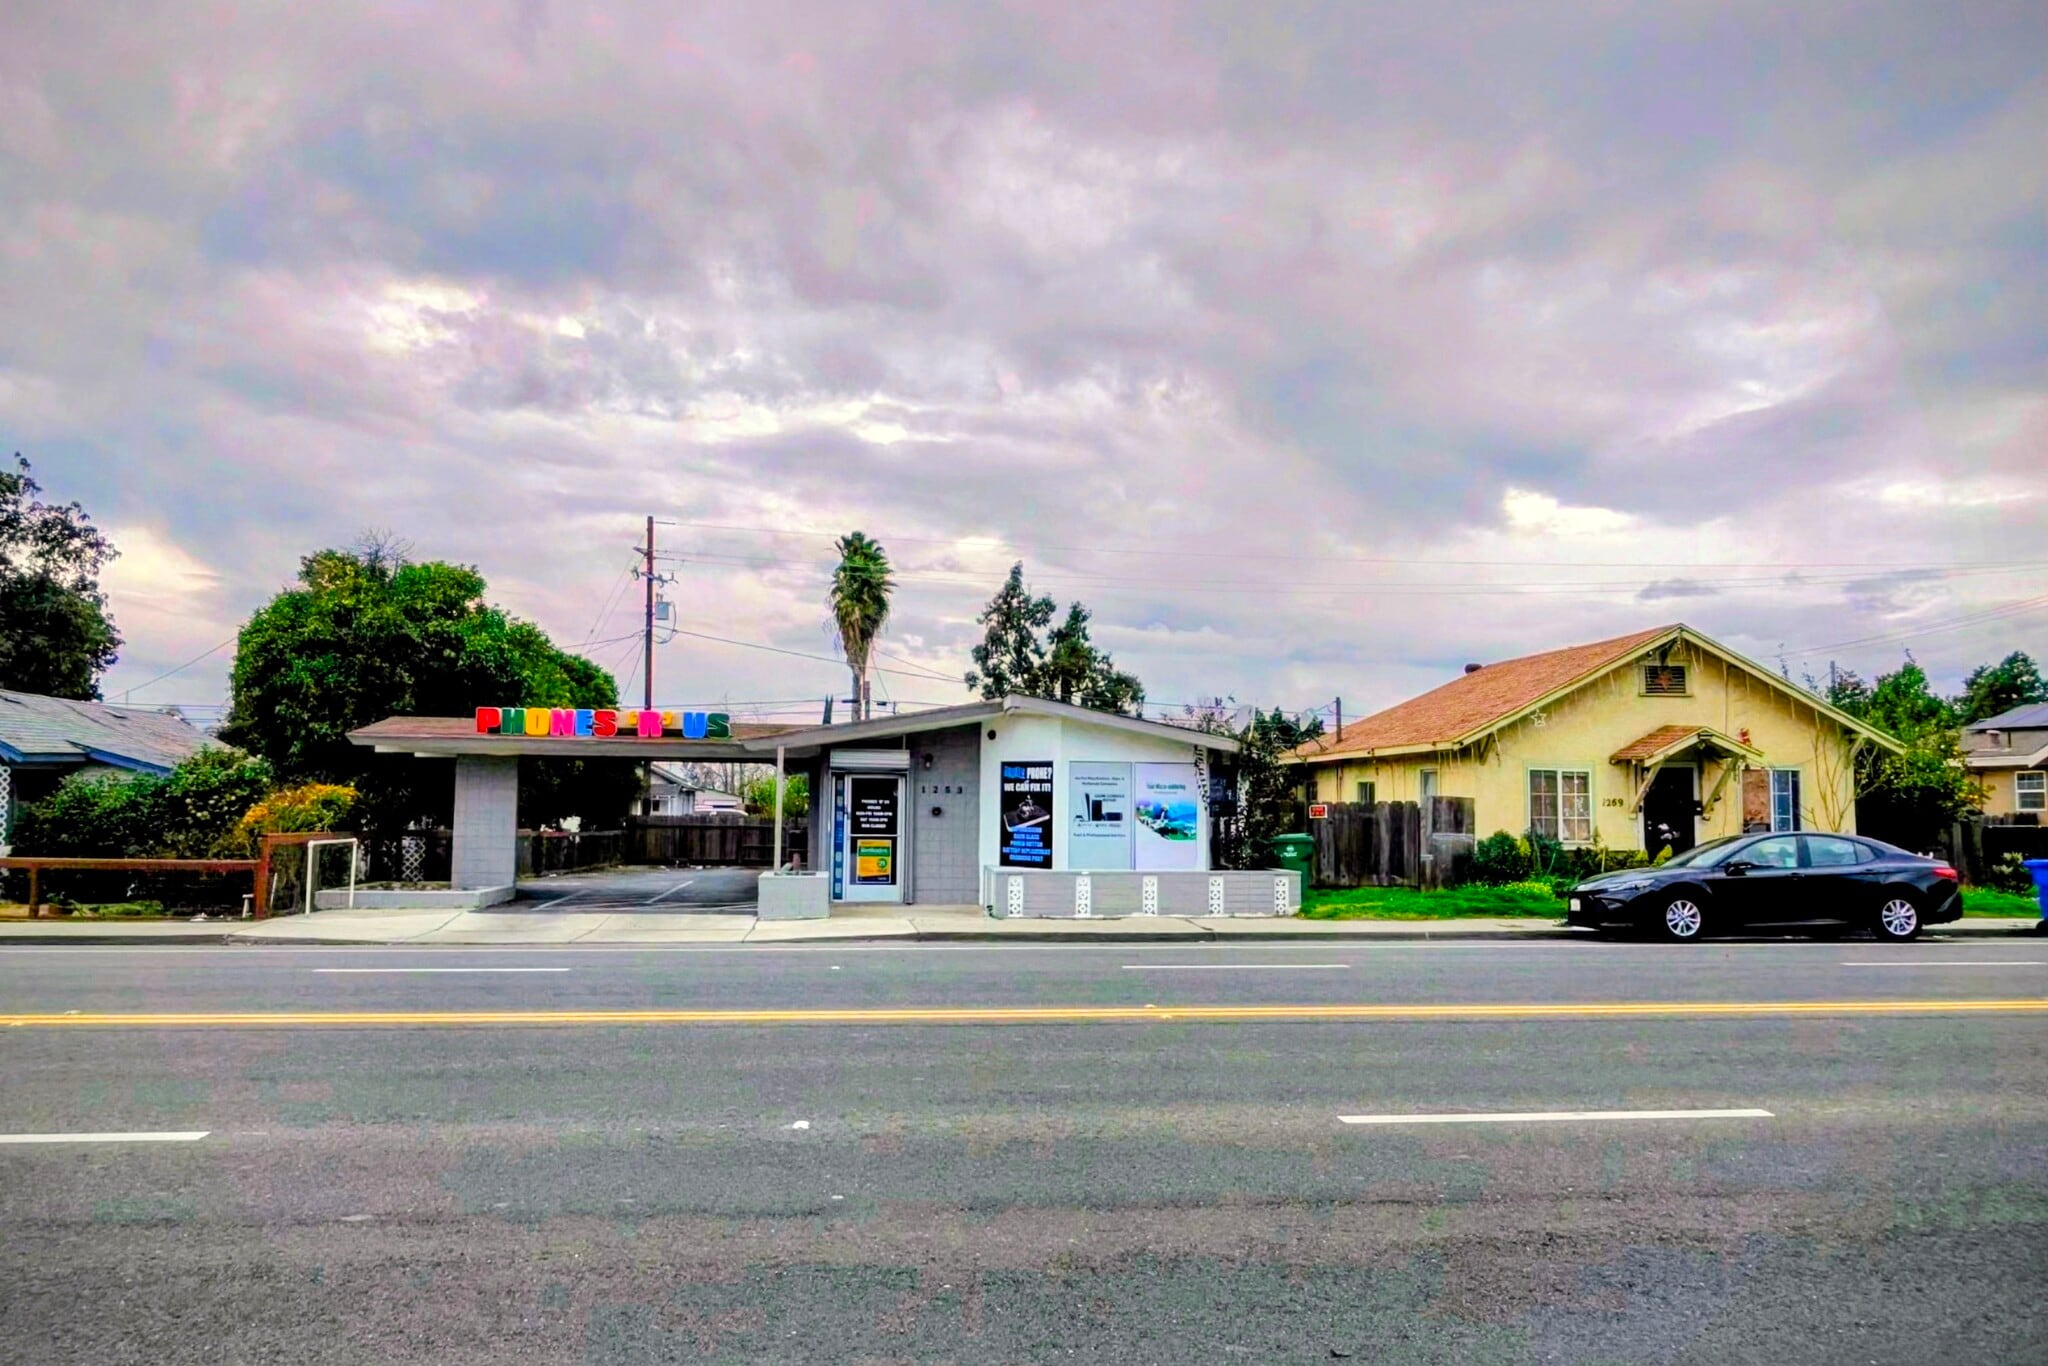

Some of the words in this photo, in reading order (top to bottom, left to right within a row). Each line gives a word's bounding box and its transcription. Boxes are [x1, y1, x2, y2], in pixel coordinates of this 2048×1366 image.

[476, 707, 617, 737] PHONES
[682, 712, 731, 739] US
[1026, 767, 1052, 780] PHONE?
[1003, 783, 1014, 792] WE
[1015, 783, 1029, 792] CAN
[1030, 783, 1041, 792] FIX
